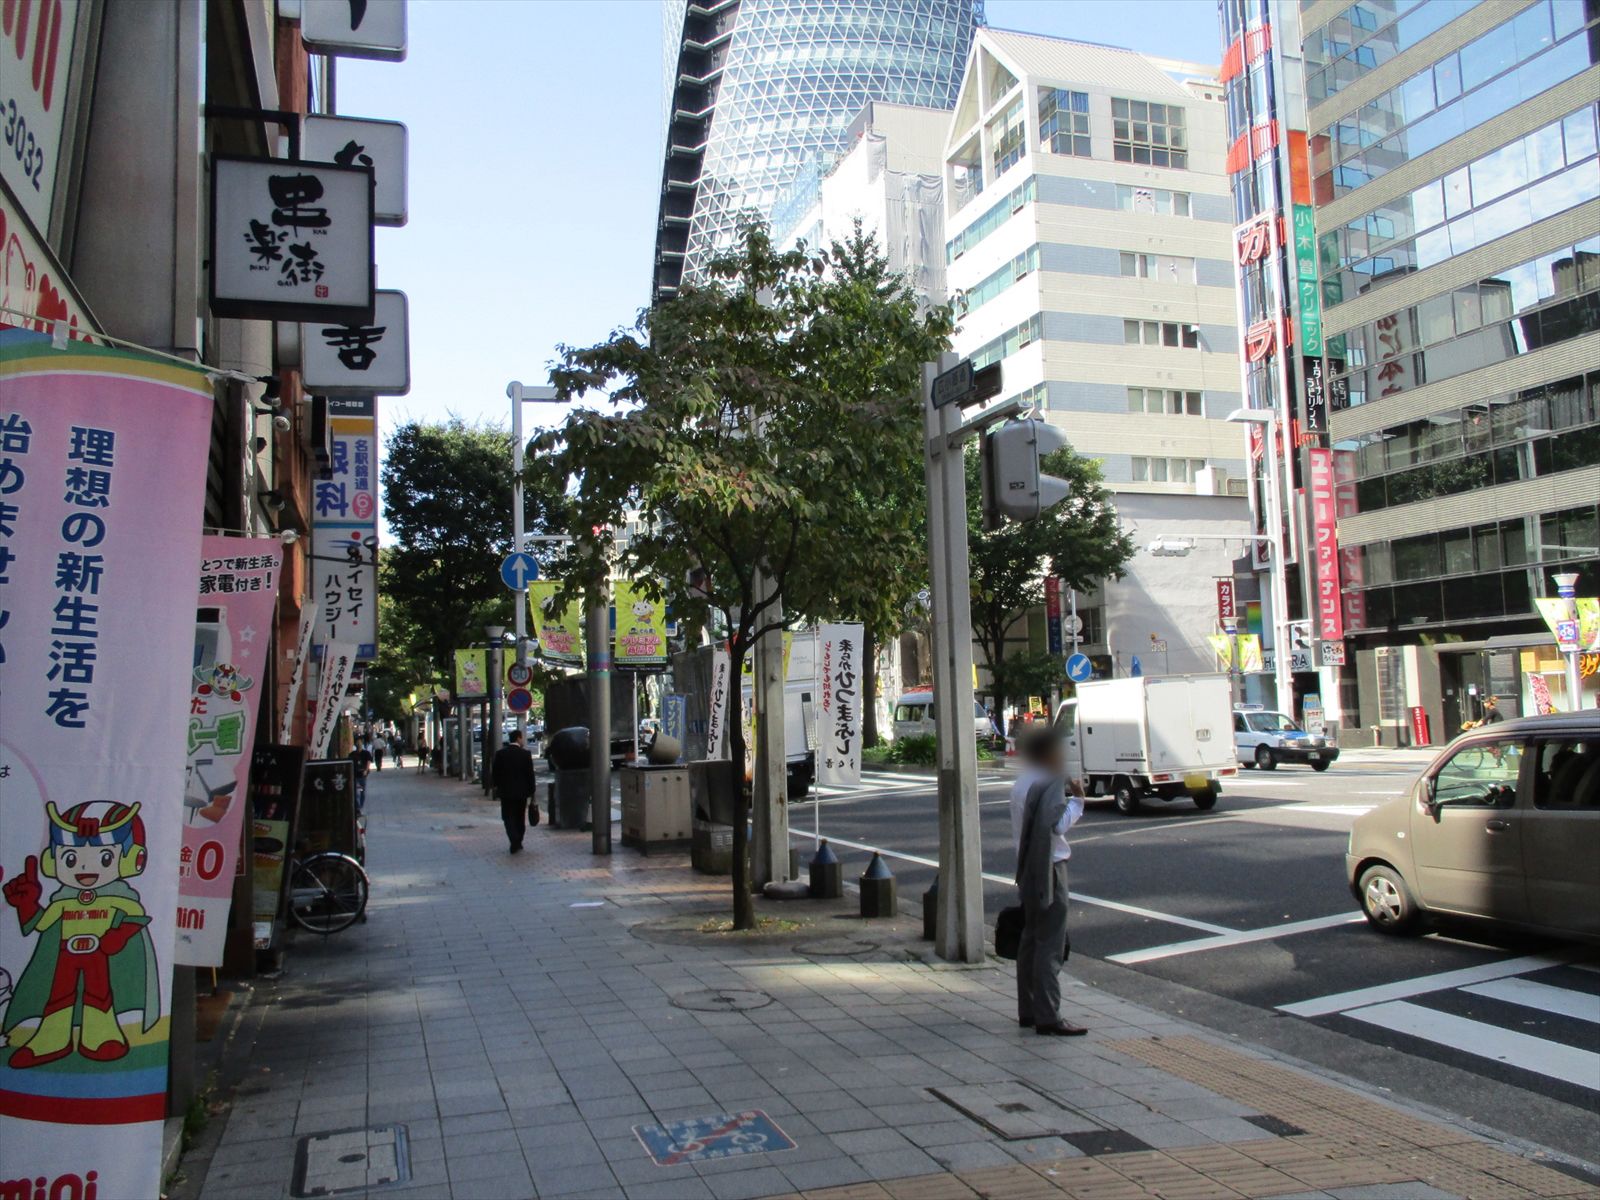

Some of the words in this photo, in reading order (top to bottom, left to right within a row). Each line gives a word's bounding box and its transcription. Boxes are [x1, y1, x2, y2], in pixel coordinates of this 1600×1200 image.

[1307, 378, 1318, 429] ラビリンス
[1313, 359, 1324, 406] エターナル
[1311, 453, 1337, 633] ユニーファイナンス
[45, 425, 116, 729] 理想の新生活を
[1221, 584, 1231, 616] カラオ
[325, 574, 342, 639] ハウジー
